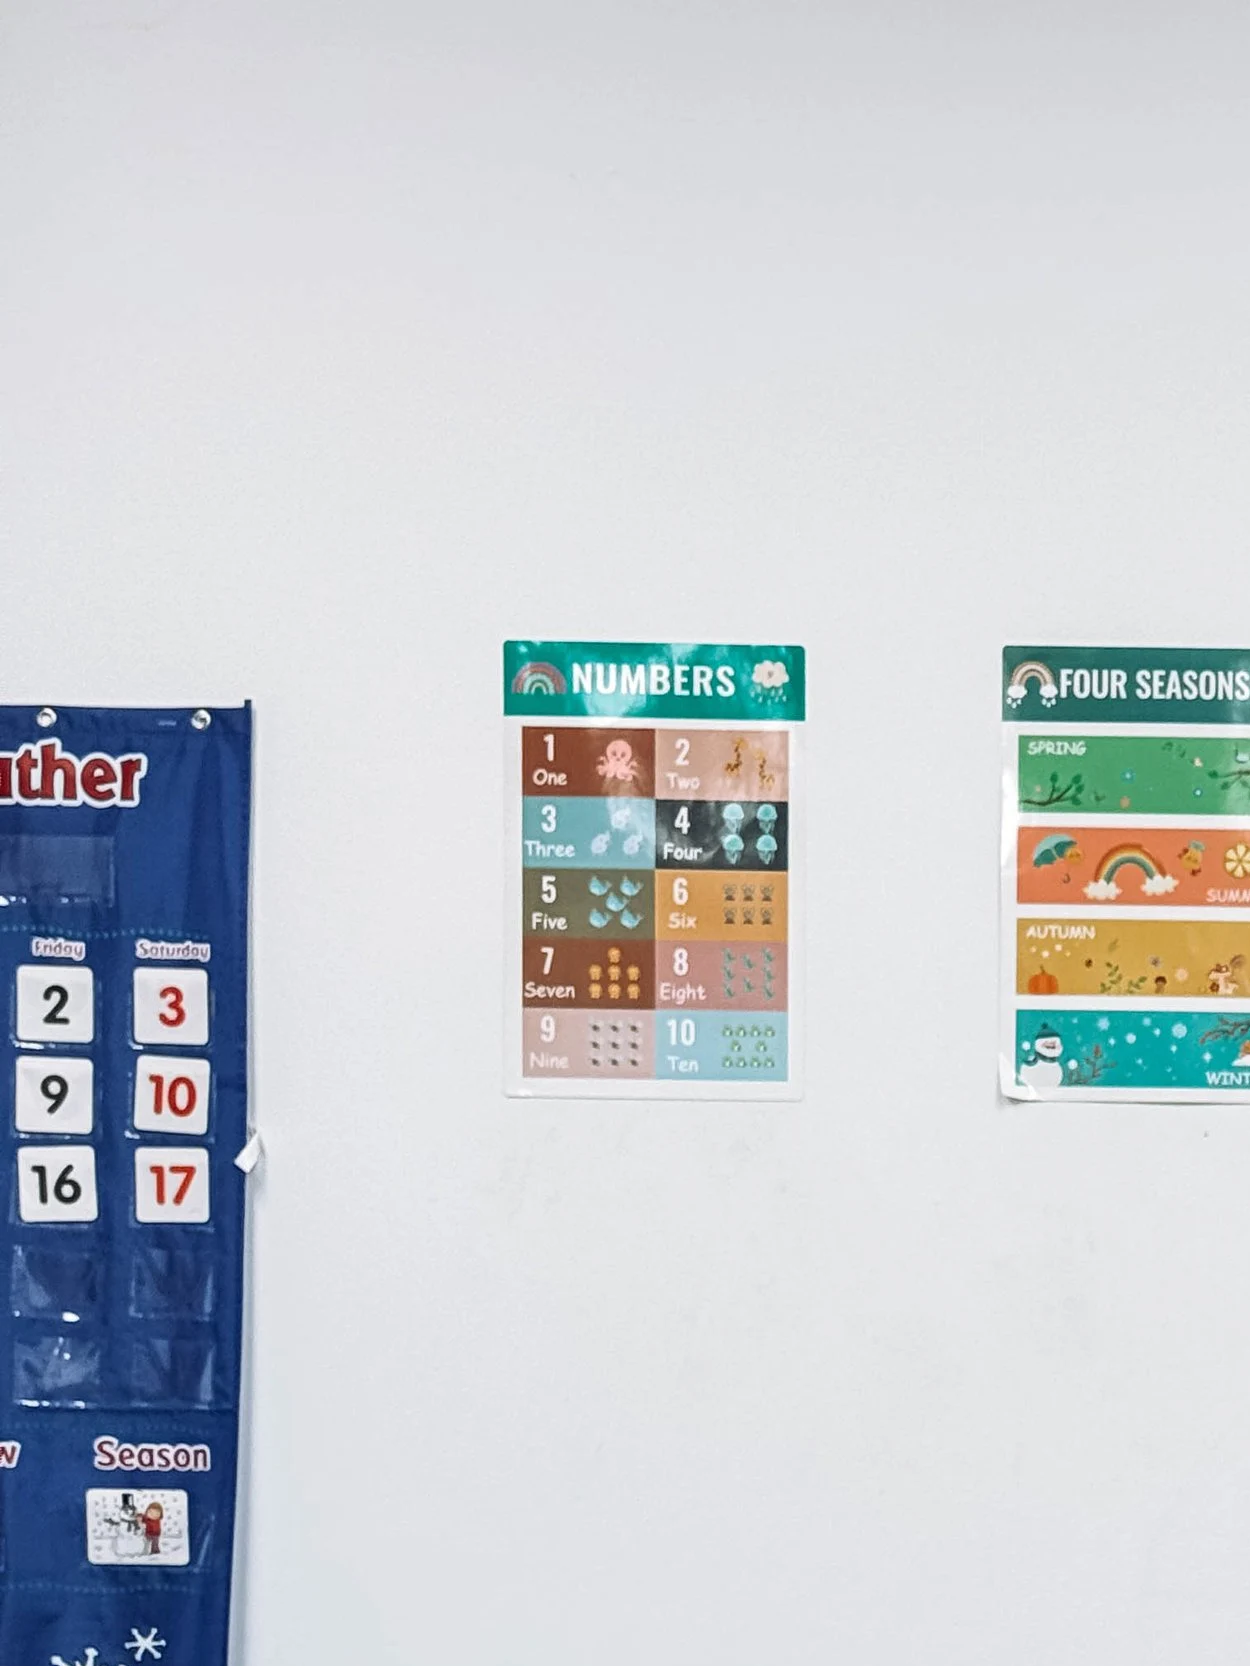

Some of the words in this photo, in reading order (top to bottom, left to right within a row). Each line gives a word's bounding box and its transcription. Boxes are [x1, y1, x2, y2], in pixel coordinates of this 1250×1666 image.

[571, 662, 736, 698] NUMBERS
[1058, 668, 1128, 700] FOUR
[1135, 669, 1250, 701] SEASONS
[543, 734, 555, 762] 1
[675, 738, 691, 766] 2
[1027, 740, 1087, 756] SPRING
[532, 769, 567, 787] One
[665, 773, 701, 791] Two
[541, 805, 557, 833] 3
[674, 807, 691, 835] 4
[524, 839, 576, 858] Three
[662, 842, 703, 861] Four
[541, 875, 557, 904] 5
[672, 877, 689, 905] 6
[531, 911, 568, 931] Five
[668, 912, 698, 930] Six
[1025, 924, 1096, 940] AUTUMN
[35, 940, 84, 960] Friday
[138, 941, 209, 962] Saturday
[541, 946, 555, 975] 7
[673, 947, 689, 976] 8
[42, 984, 71, 1025] 2
[524, 982, 576, 1001] Seven
[659, 982, 707, 1002] Eight
[158, 985, 186, 1027] 3
[540, 1014, 556, 1043] 9
[667, 1017, 697, 1046] 10
[529, 1052, 570, 1070] Nine
[667, 1055, 699, 1073] Ten
[40, 1074, 69, 1114] 9
[148, 1074, 197, 1118] 10
[30, 1164, 82, 1206] 16
[148, 1165, 197, 1206] 17
[96, 1441, 209, 1470] Season
